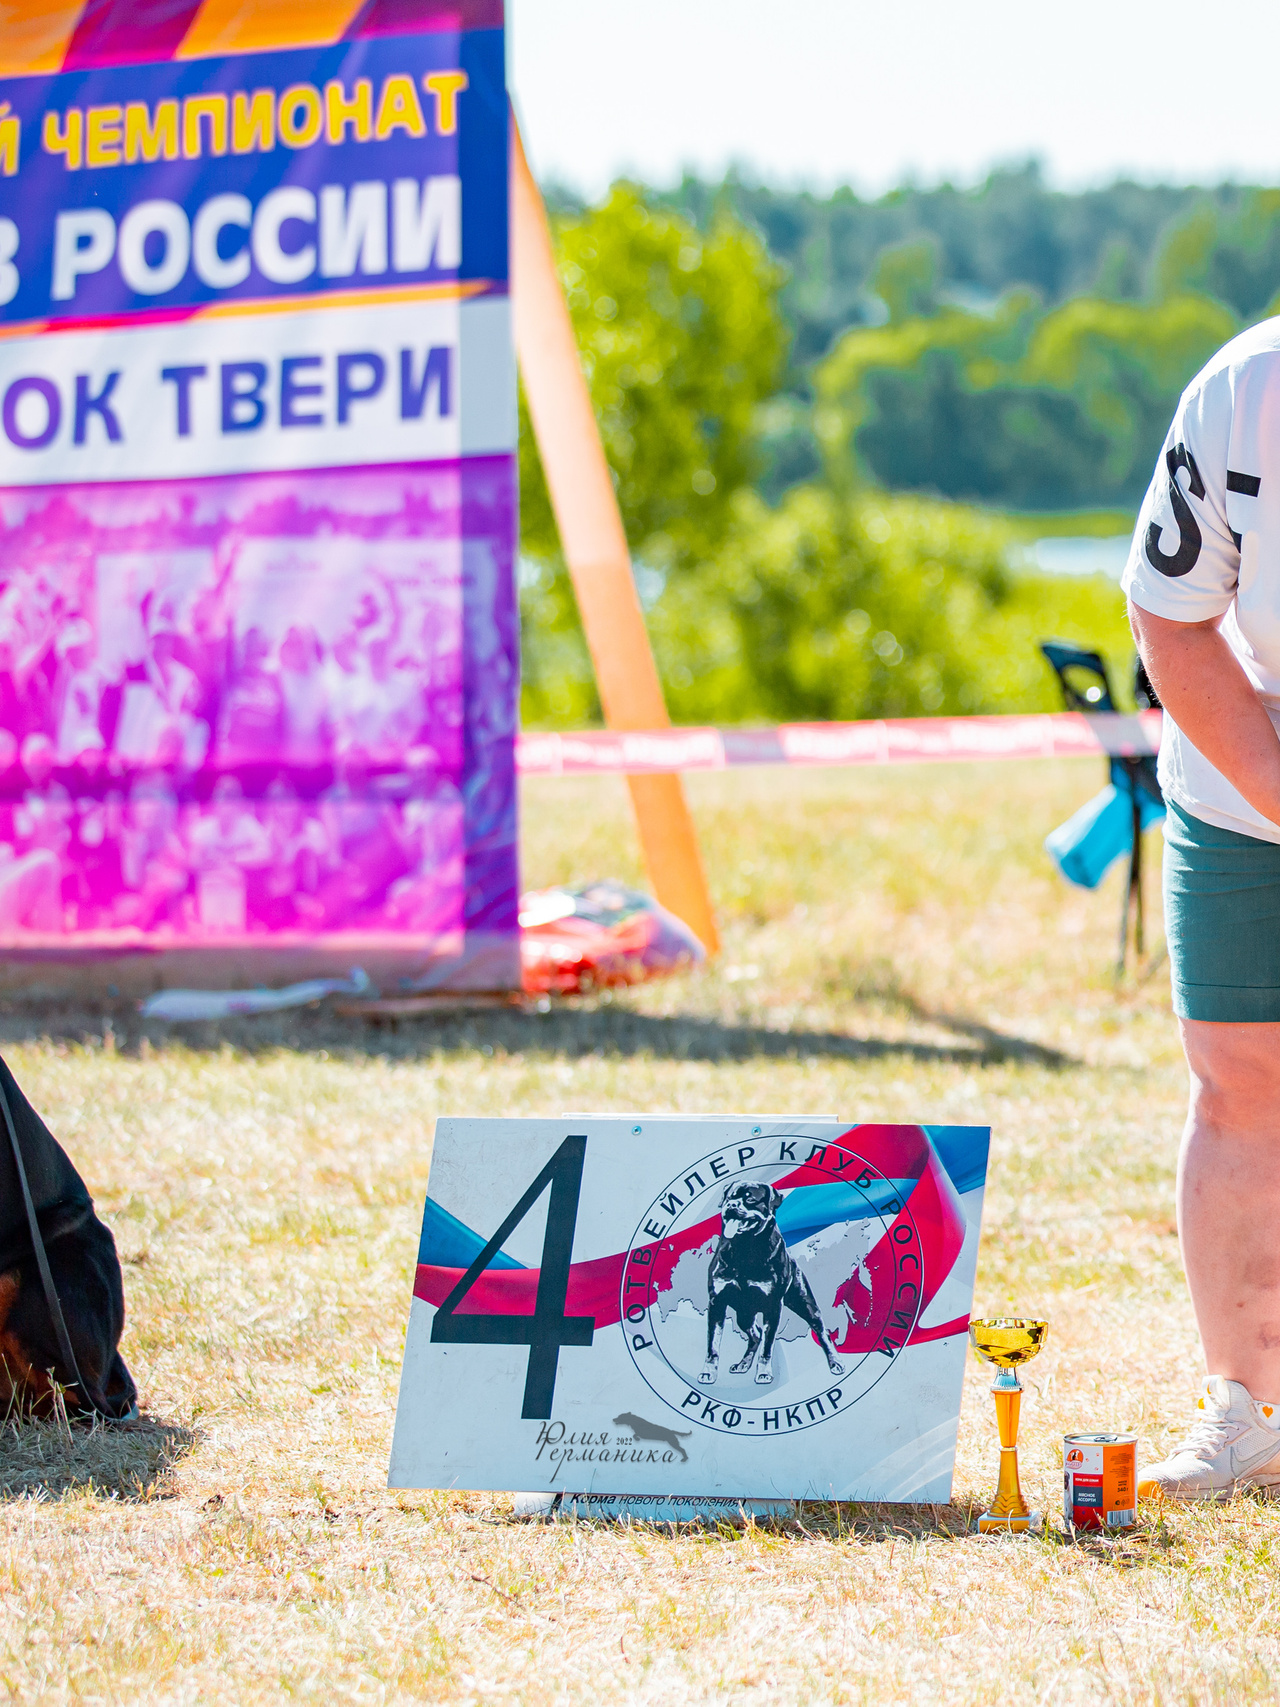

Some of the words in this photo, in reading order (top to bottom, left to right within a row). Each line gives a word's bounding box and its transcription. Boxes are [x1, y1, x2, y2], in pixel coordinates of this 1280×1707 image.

[43, 70, 468, 172] ЧЕМПИОНАТ
[52, 176, 461, 300] РОССИИ
[1, 371, 125, 452] ОК
[161, 345, 455, 438] ТВЕРИ
[430, 1134, 596, 1420] 4
[625, 1146, 756, 1352] РОТВЕЙЛЕР
[778, 1141, 877, 1190] КЛУБ
[876, 1197, 919, 1360] РОССИИ
[681, 1387, 844, 1431] РКФ-НКПР
[618, 1495, 666, 1506] нового
[667, 1496, 739, 1508] поколения
